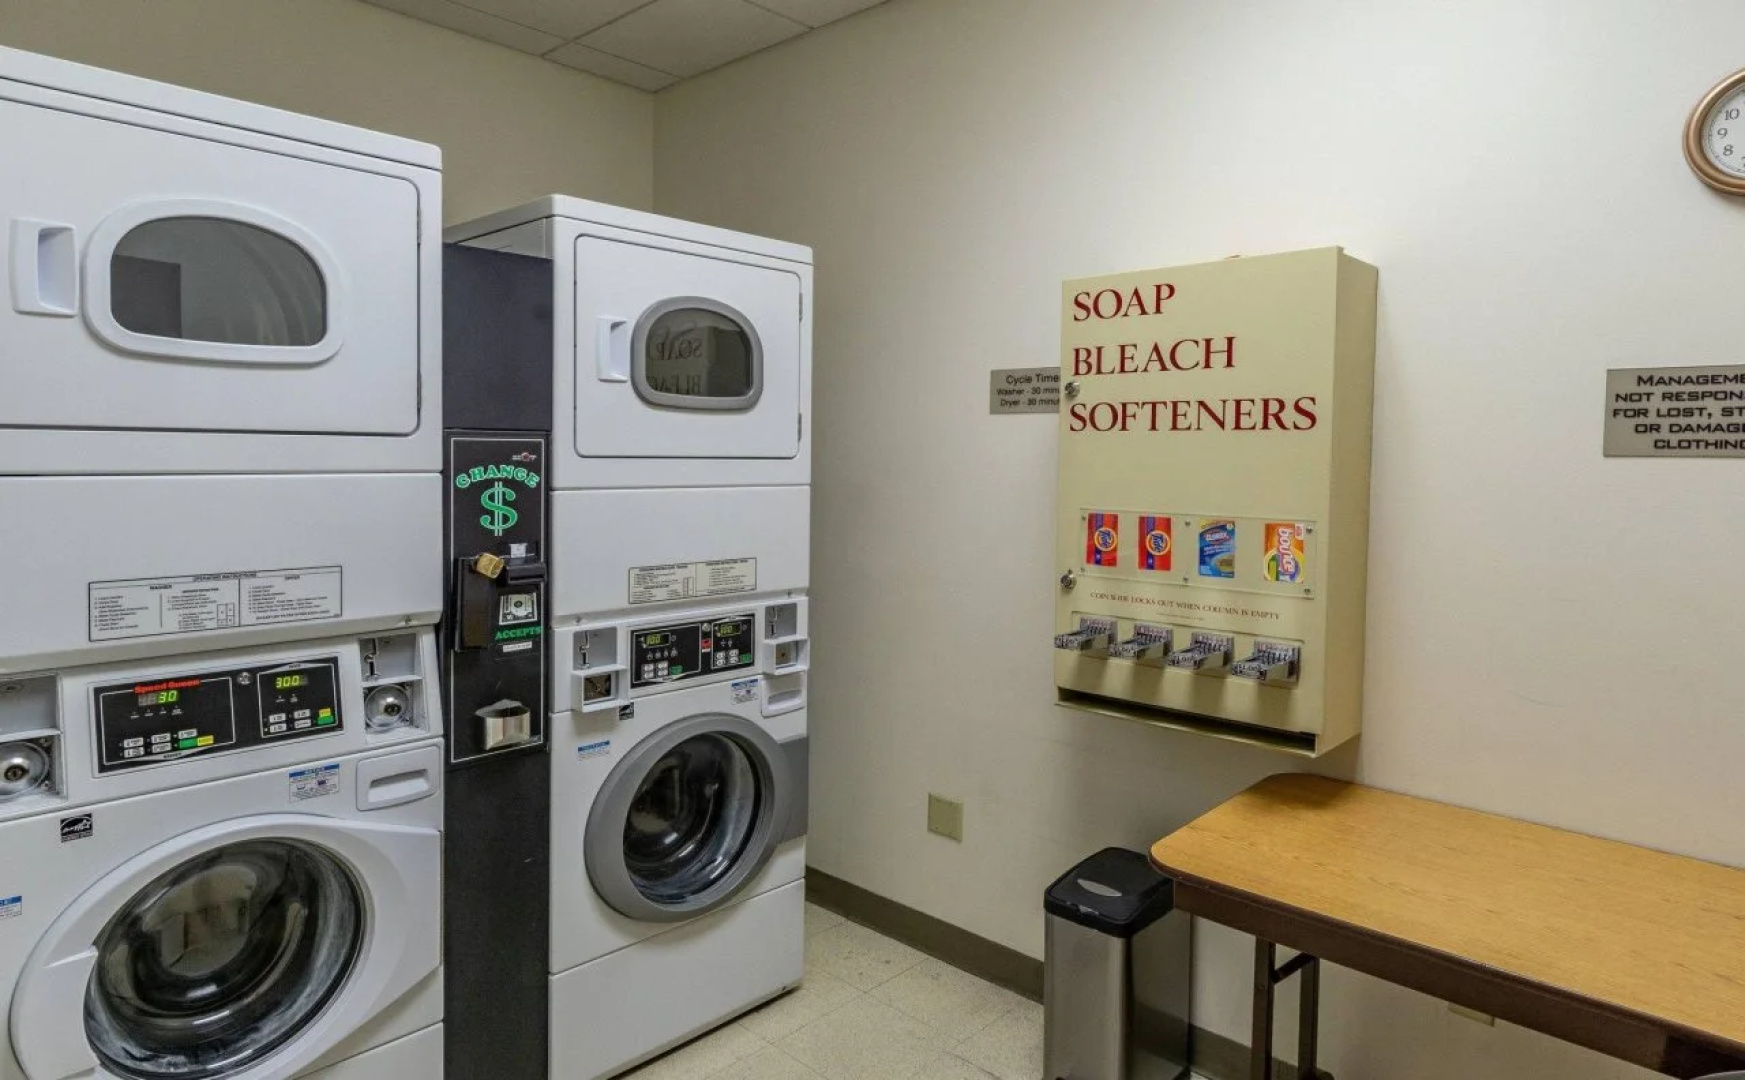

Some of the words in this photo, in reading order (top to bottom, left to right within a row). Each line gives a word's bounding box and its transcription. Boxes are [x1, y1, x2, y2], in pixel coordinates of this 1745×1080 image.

[1725, 108, 1740, 121] 10
[1717, 127, 1728, 139] 9
[1722, 144, 1734, 156] 8
[1073, 283, 1175, 322] SOAP
[1073, 336, 1236, 376] BLEACH
[1005, 374, 1033, 386] Cycle
[1035, 373, 1060, 383] Time
[1615, 392, 1655, 403] NOT
[1661, 390, 1745, 402] RESPON
[1000, 399, 1021, 408] Dryer
[1069, 396, 1318, 432] SOFTENERS
[1613, 408, 1649, 418] FOR
[1656, 407, 1713, 420] LOST,
[1721, 406, 1745, 417] ST
[1634, 423, 1662, 434] OR
[1668, 423, 1745, 434] DAMAG
[456, 464, 541, 489] CHANGE
[1090, 592, 1109, 600] COIN
[1131, 596, 1156, 605] LOCKS
[1157, 599, 1174, 607] OUT
[1176, 601, 1201, 610] WHEN
[1241, 608, 1250, 616] IS
[1250, 610, 1279, 620] EMPTY
[494, 626, 543, 641] ACCEPTS
[134, 683, 167, 694] Speed
[168, 678, 201, 688] Queen
[275, 675, 300, 688] 300
[158, 690, 178, 703] 30
